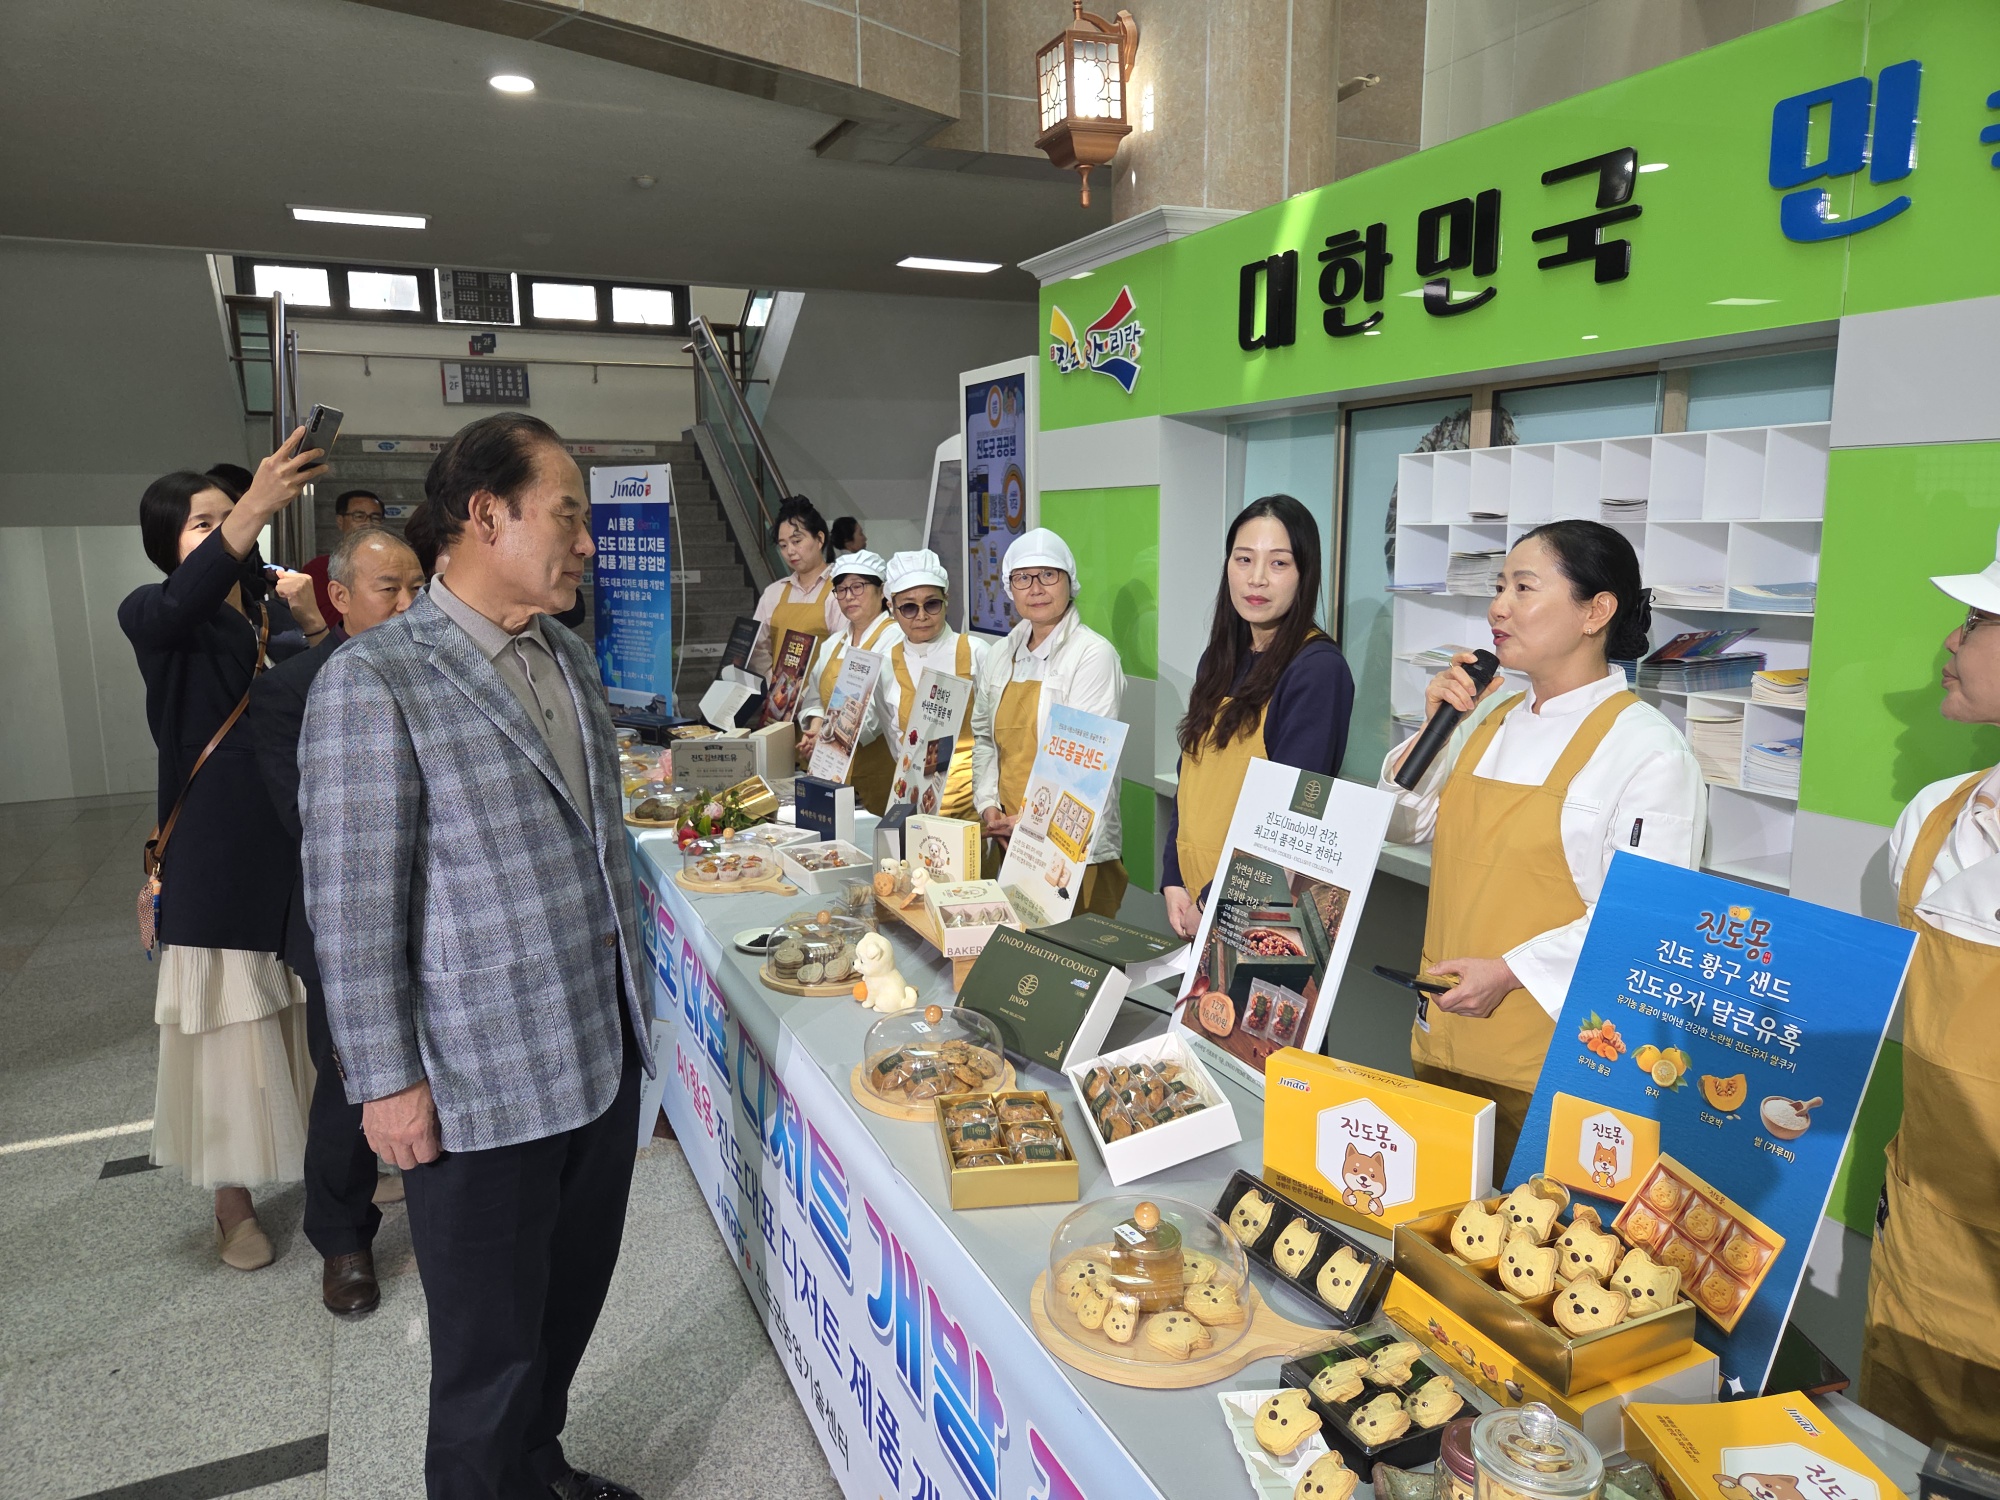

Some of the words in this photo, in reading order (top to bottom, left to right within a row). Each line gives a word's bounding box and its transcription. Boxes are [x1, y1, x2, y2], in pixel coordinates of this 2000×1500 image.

[1238, 146, 1643, 352] 대한민국
[483, 337, 492, 346] 2F
[449, 382, 459, 390] 2F
[610, 480, 644, 498] Jindo
[607, 518, 617, 530] AI
[619, 518, 634, 531] 활용
[598, 537, 616, 551] 진도
[618, 537, 636, 552] 대표
[638, 537, 665, 552] 디저트
[598, 555, 616, 569] 제품
[619, 555, 636, 570] 개발
[638, 556, 665, 572] 창업반
[600, 577, 610, 586] 진도
[611, 578, 621, 587] 대표
[622, 578, 637, 588] 디저트
[1049, 735, 1104, 771] 진도몽글샌드
[1266, 812, 1318, 839] 진도(Jindo)의
[1319, 828, 1338, 848] 건강,
[1254, 825, 1279, 844] 최고의
[1279, 833, 1313, 855] 품격으로
[1315, 845, 1342, 867] 전하다
[1231, 875, 1250, 891] 빚어낸
[1234, 862, 1253, 879] 자연의
[1254, 869, 1273, 886] 선물로
[1227, 888, 1246, 904] 진정한
[1246, 896, 1259, 910] 건강
[1108, 923, 1142, 939] HEALTHY
[1141, 933, 1173, 947] COOKIES
[1696, 912, 1771, 960] 진도몽
[947, 946, 985, 956] BAKER
[998, 933, 1023, 951] JINDO
[1023, 943, 1061, 964] HEALTHY
[1060, 956, 1099, 978] COOKIES
[1656, 939, 1695, 969] 진도
[1699, 952, 1741, 986] 황구
[1746, 971, 1791, 1003] 샌드
[1009, 994, 1029, 1007] JINDO
[1211, 999, 1225, 1014] 12개
[1626, 968, 1706, 1017] 진도유자
[1711, 998, 1803, 1055] 달큰유혹
[1202, 1008, 1228, 1030] 18,000원
[1616, 994, 1638, 1010] 유기농
[1638, 1002, 1660, 1018] 울금이
[1661, 1011, 1685, 1028] 빚어낸
[1685, 1021, 1708, 1038] 건강한
[1709, 1031, 1734, 1049] 노란빛
[1735, 1041, 1769, 1062] 진도유자
[1770, 1053, 1797, 1074] 쌀쿠키
[1578, 1055, 1597, 1070] 유기농
[1597, 1063, 1611, 1077] 울금
[1277, 1077, 1305, 1091] Jindo
[1645, 1086, 1660, 1099] 유자
[1700, 1111, 1724, 1130] 단호박
[1340, 1116, 1392, 1149] 진도몽
[1592, 1122, 1622, 1144] 진도몽
[1753, 1136, 1763, 1149] 쌀
[1763, 1140, 1796, 1165] (가루미)
[640, 879, 678, 1001] 진도
[681, 936, 731, 1087] 대표
[737, 1018, 851, 1284] 디저트
[863, 1196, 1006, 1500] 개발
[716, 1182, 745, 1263] Jindo
[756, 1261, 850, 1472] 진도군농업기술센터
[781, 1223, 843, 1380] 디저트
[849, 1342, 902, 1493] 제품
[1783, 1406, 1815, 1434] Jindo
